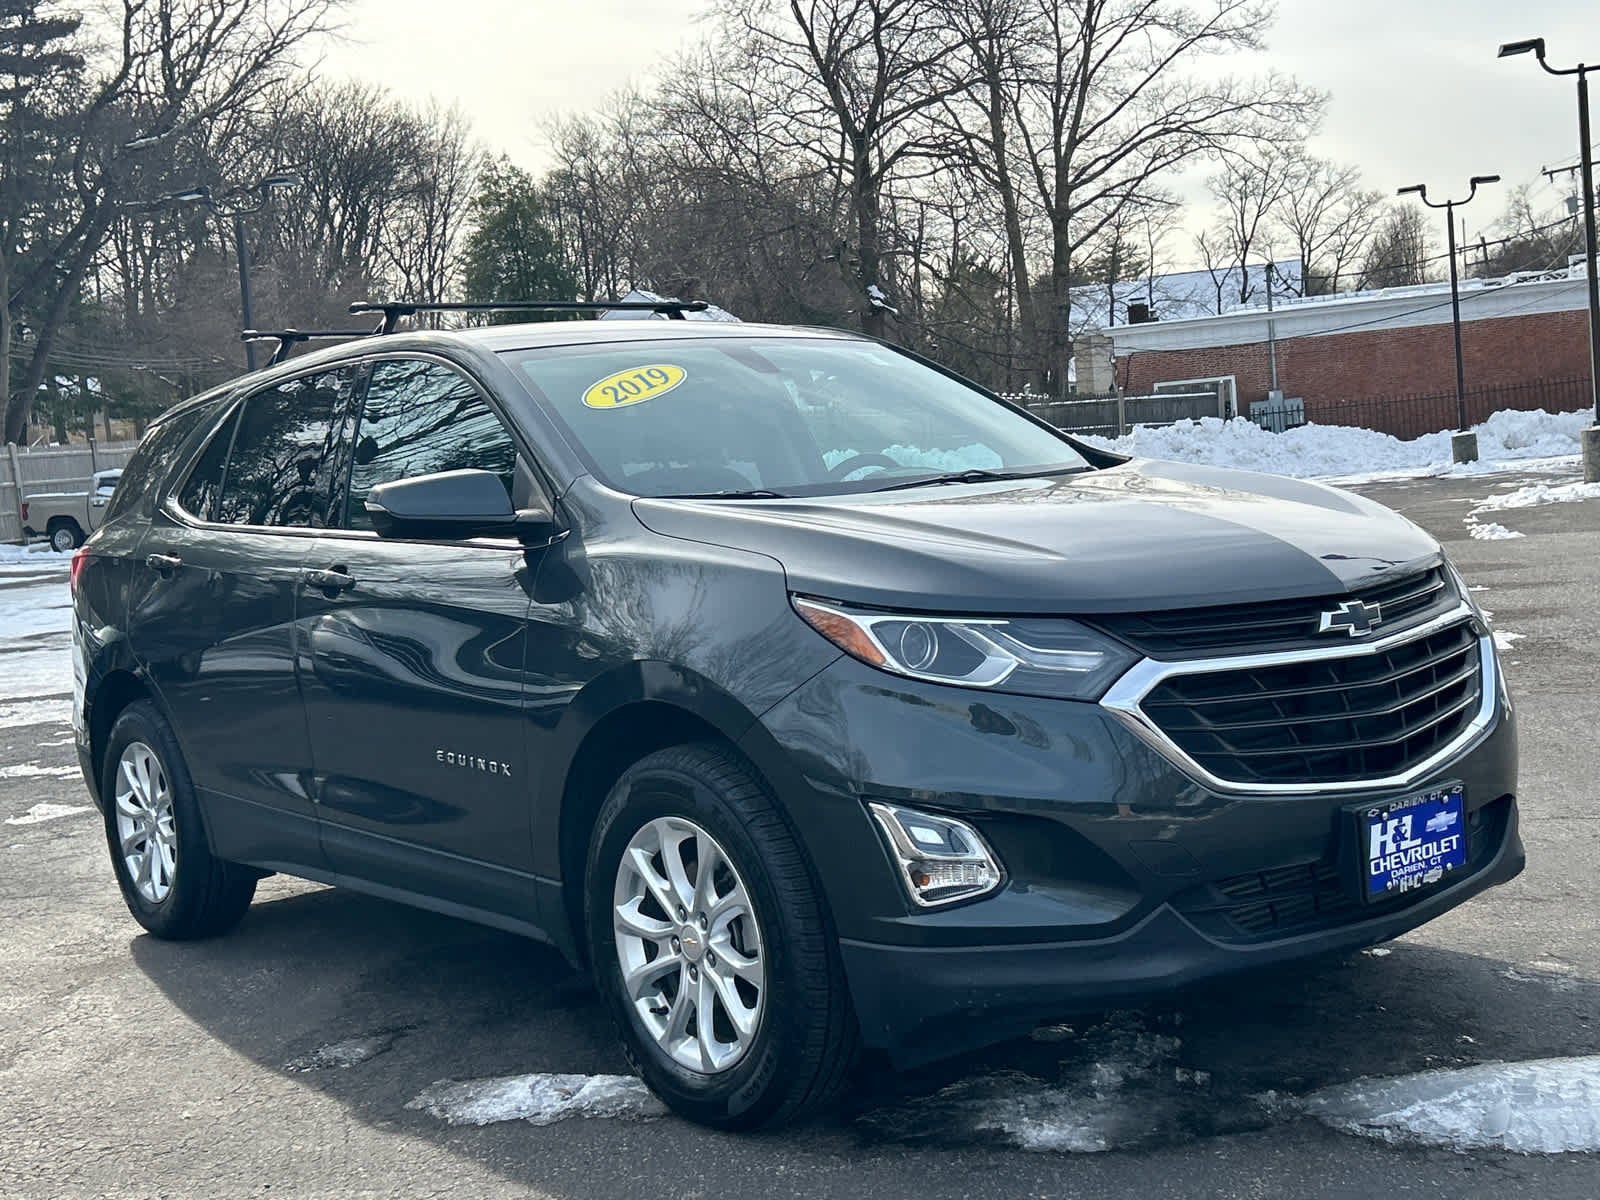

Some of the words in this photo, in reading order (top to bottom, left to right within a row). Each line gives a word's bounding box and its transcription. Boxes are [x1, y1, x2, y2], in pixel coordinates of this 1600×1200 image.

[601, 368, 670, 403] 2019
[436, 750, 511, 776] EQUINOX
[1369, 814, 1421, 860] H&L
[1370, 834, 1460, 875] CHEVROLET
[1430, 855, 1442, 866] CT
